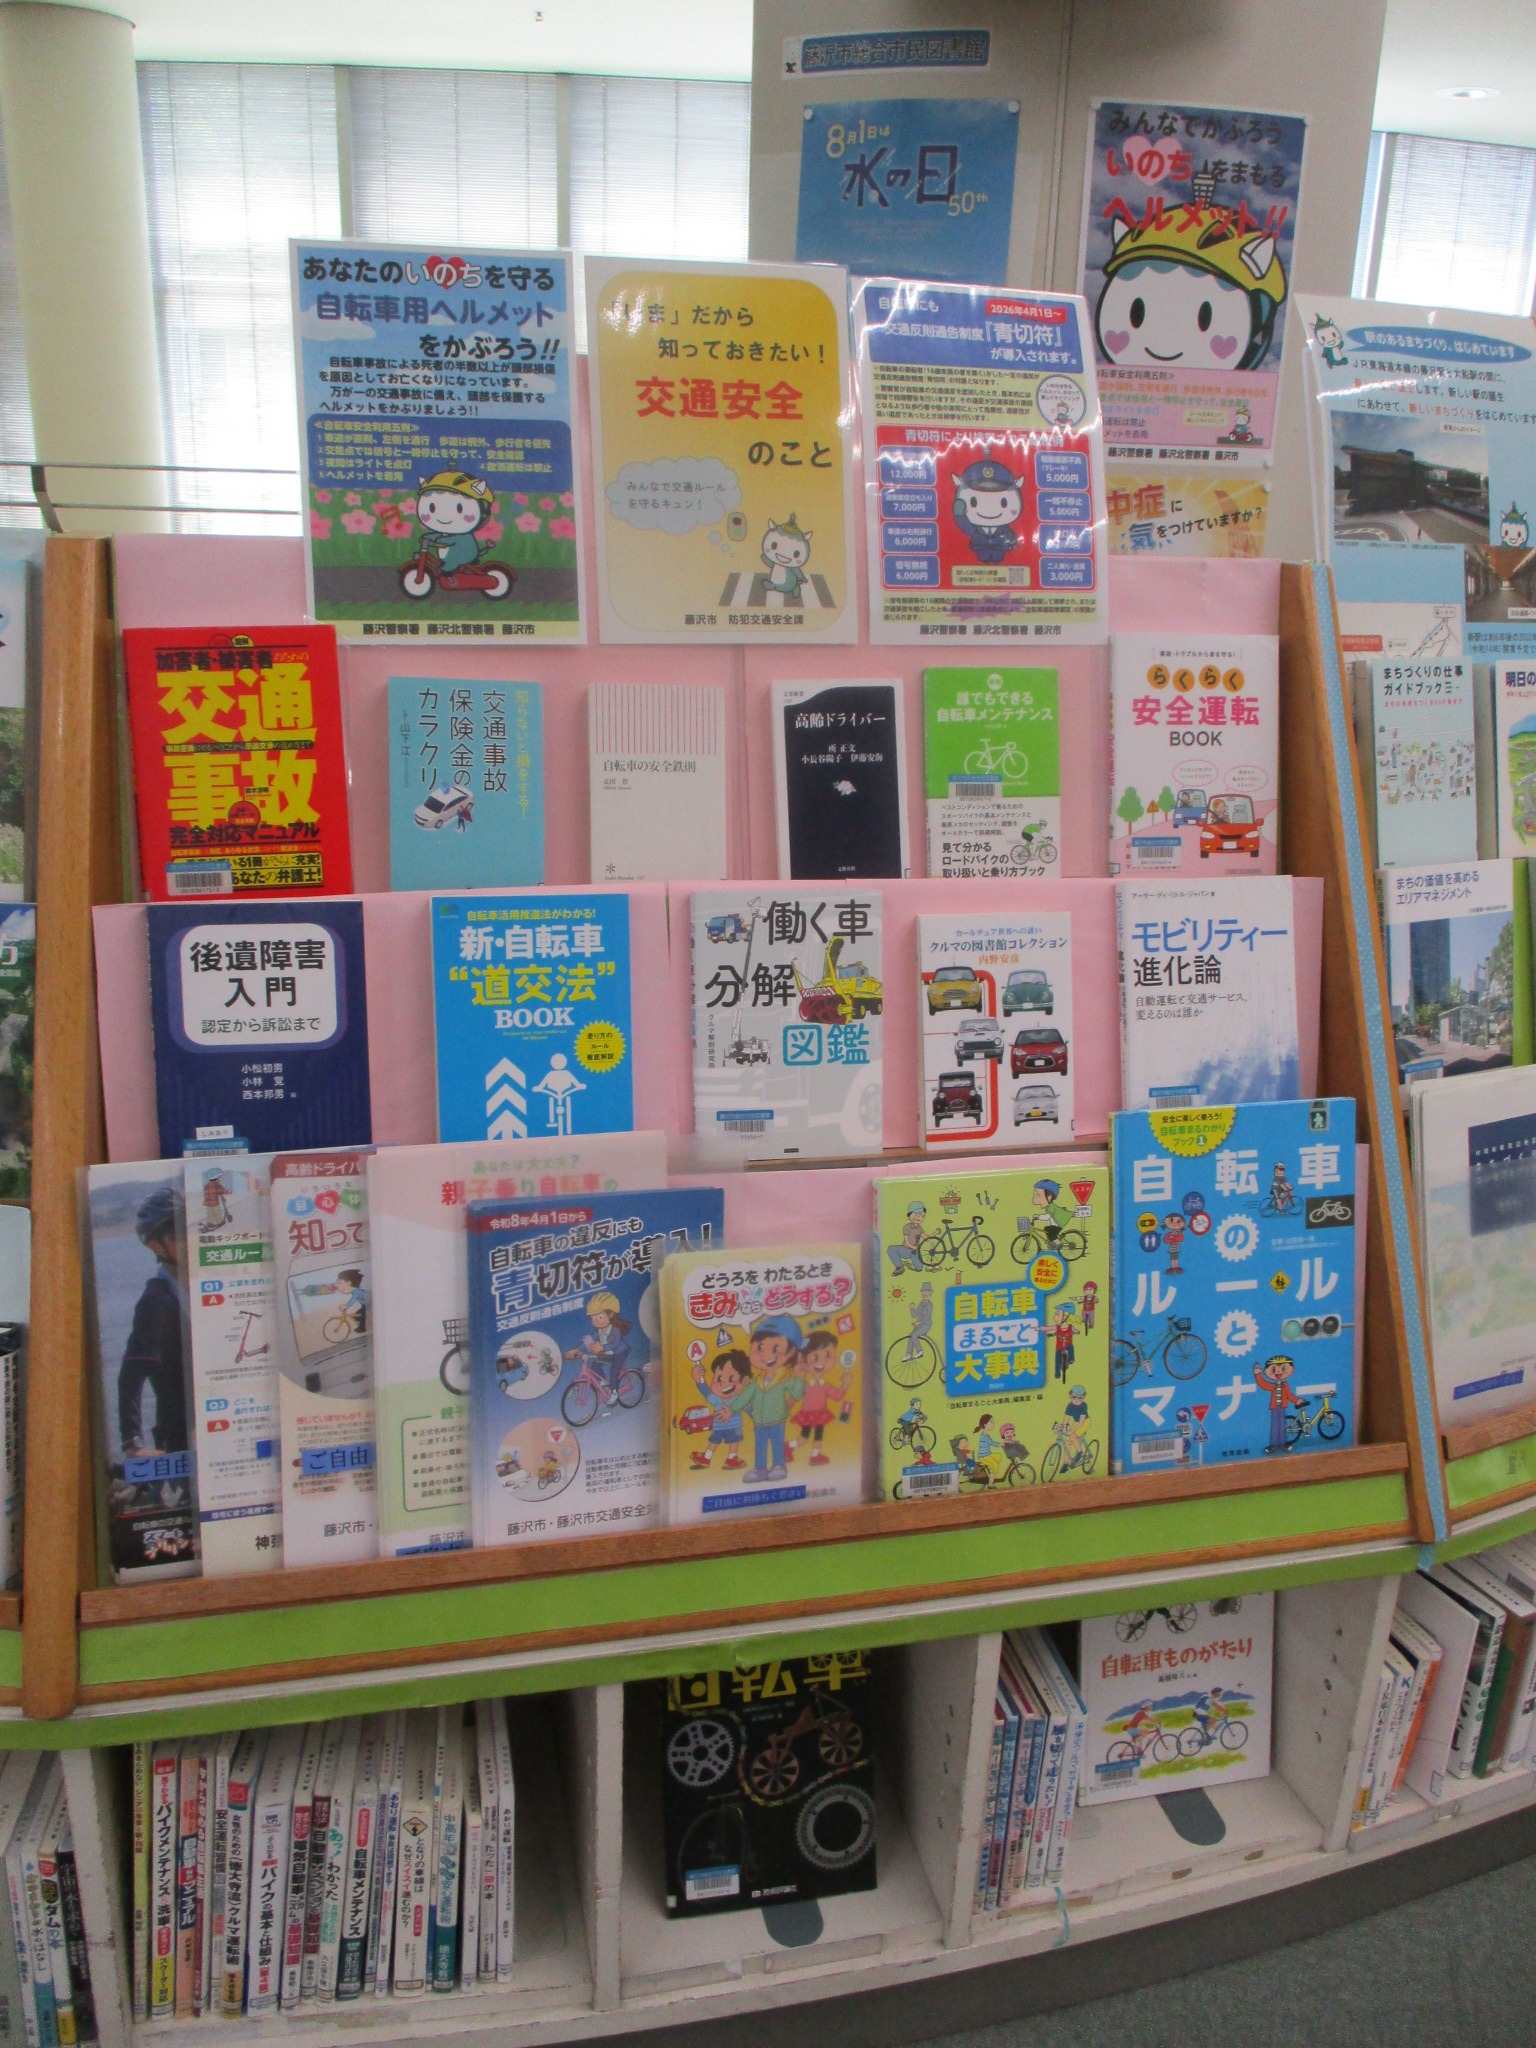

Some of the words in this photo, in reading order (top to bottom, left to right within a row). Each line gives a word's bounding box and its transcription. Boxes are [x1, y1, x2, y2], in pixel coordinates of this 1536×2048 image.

[842, 145, 962, 208] 水の日
[303, 255, 555, 292] あなたのいのちを守る
[316, 292, 554, 327] 自転車用ヘルメット
[879, 298, 939, 312] 自にも
[635, 376, 804, 421] 交通安全
[748, 441, 832, 468] のこと
[502, 624, 535, 636] 藤沢市
[685, 614, 717, 625] 藤沢市
[728, 614, 804, 626] 防犯交通安全課
[1153, 667, 1240, 690] らくらく
[1383, 665, 1463, 680] まちづくりの仕事
[158, 663, 317, 745] 交通
[1132, 695, 1260, 726] 安全運転
[795, 712, 886, 730] 高齢ドライバー
[937, 709, 1054, 723] 自転車メンテナンス
[418, 687, 438, 791] カラクリ
[450, 689, 474, 786] 保険金の
[483, 690, 507, 793] 交通事故
[1169, 731, 1223, 747] BOOK
[603, 759, 697, 774] 自転車の安全鉄則
[164, 750, 320, 831] 事故
[169, 822, 320, 845] 完全対応マニュアル
[942, 842, 992, 854] 見て分かる
[942, 854, 1010, 866] ロードバイクの
[942, 866, 1046, 879] 取り扱いと乗り方ブック
[763, 899, 873, 945] 働く車
[459, 923, 605, 961] 新・自転車
[930, 938, 1068, 953] クルマの図書館コレクション
[1132, 917, 1287, 953] モビリティー
[190, 939, 326, 973] 後遺障害
[978, 954, 1020, 965] 内野安彦
[1133, 955, 1222, 986] 進化論
[224, 977, 297, 1008] 入門
[704, 963, 797, 1009] 分解
[1136, 993, 1248, 1007] 自動運転と交通サービス、
[201, 1017, 321, 1034] 認定から訴訟まで
[495, 1007, 575, 1029] BOOK
[1136, 1010, 1203, 1020] 変えるのは誰か
[586, 1032, 613, 1040] 走り方の
[591, 1042, 609, 1050] ルール
[783, 1023, 871, 1066] 図鑑
[241, 1063, 283, 1074] 小松初男
[586, 1053, 614, 1061] 徹底解説
[241, 1076, 263, 1086] 小林
[242, 1088, 284, 1099] 西本邦男
[1162, 1112, 1223, 1123] 安全に楽しく乗ろう!
[1160, 1123, 1226, 1136] 自転車まるわかり
[1173, 1136, 1195, 1147] ブック
[1133, 1143, 1341, 1203] 自転車
[490, 1212, 587, 1229] 令和8年4月1日から
[289, 1219, 364, 1256] 知って
[490, 1216, 643, 1272] 自転車の違反にも
[1224, 1224, 1250, 1250] の
[702, 1270, 758, 1289] どうろを
[764, 1262, 833, 1283] わたるとき
[1036, 1268, 1058, 1277] 安全に
[1132, 1257, 1339, 1317] ルール
[955, 1287, 1038, 1321] 自転車
[959, 1322, 1032, 1349] まるごと
[1226, 1320, 1247, 1347] と
[691, 1343, 703, 1356] A
[955, 1349, 1039, 1384] 大事典
[1133, 1375, 1337, 1427] マナー
[131, 1456, 190, 1479] ご自由
[310, 1446, 368, 1470] ご自由
[1102, 1636, 1254, 1679] 自転車ものがたり
